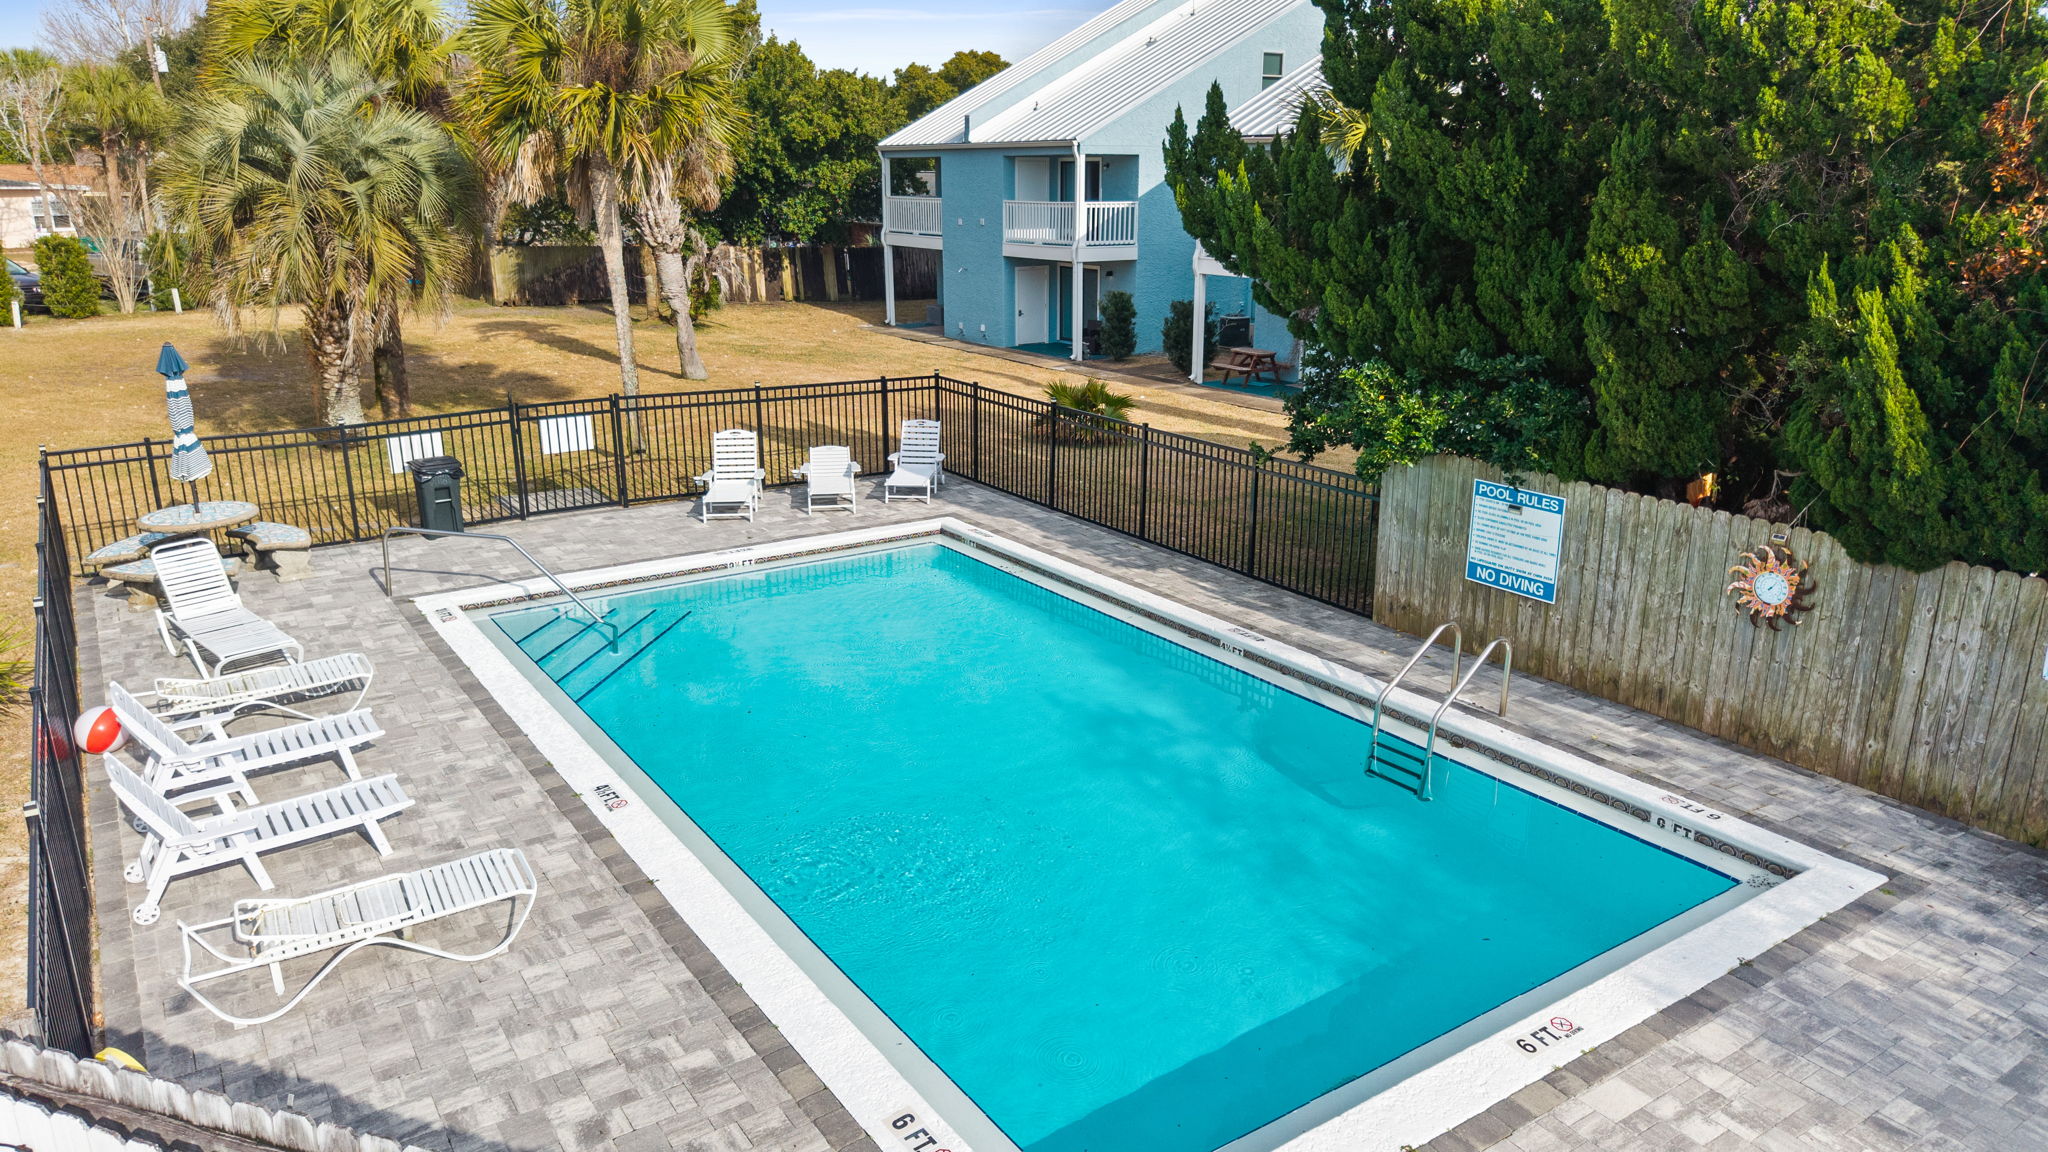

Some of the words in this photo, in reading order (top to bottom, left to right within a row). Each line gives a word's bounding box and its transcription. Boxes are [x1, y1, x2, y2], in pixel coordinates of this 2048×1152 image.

[1479, 484, 1513, 502] POOL
[1517, 493, 1559, 511] RULES
[1476, 566, 1496, 582] NO
[1499, 573, 1544, 596] DIVING
[1516, 1038, 1537, 1053] 6
[1530, 1026, 1562, 1047] FT.
[892, 1113, 916, 1130] 6
